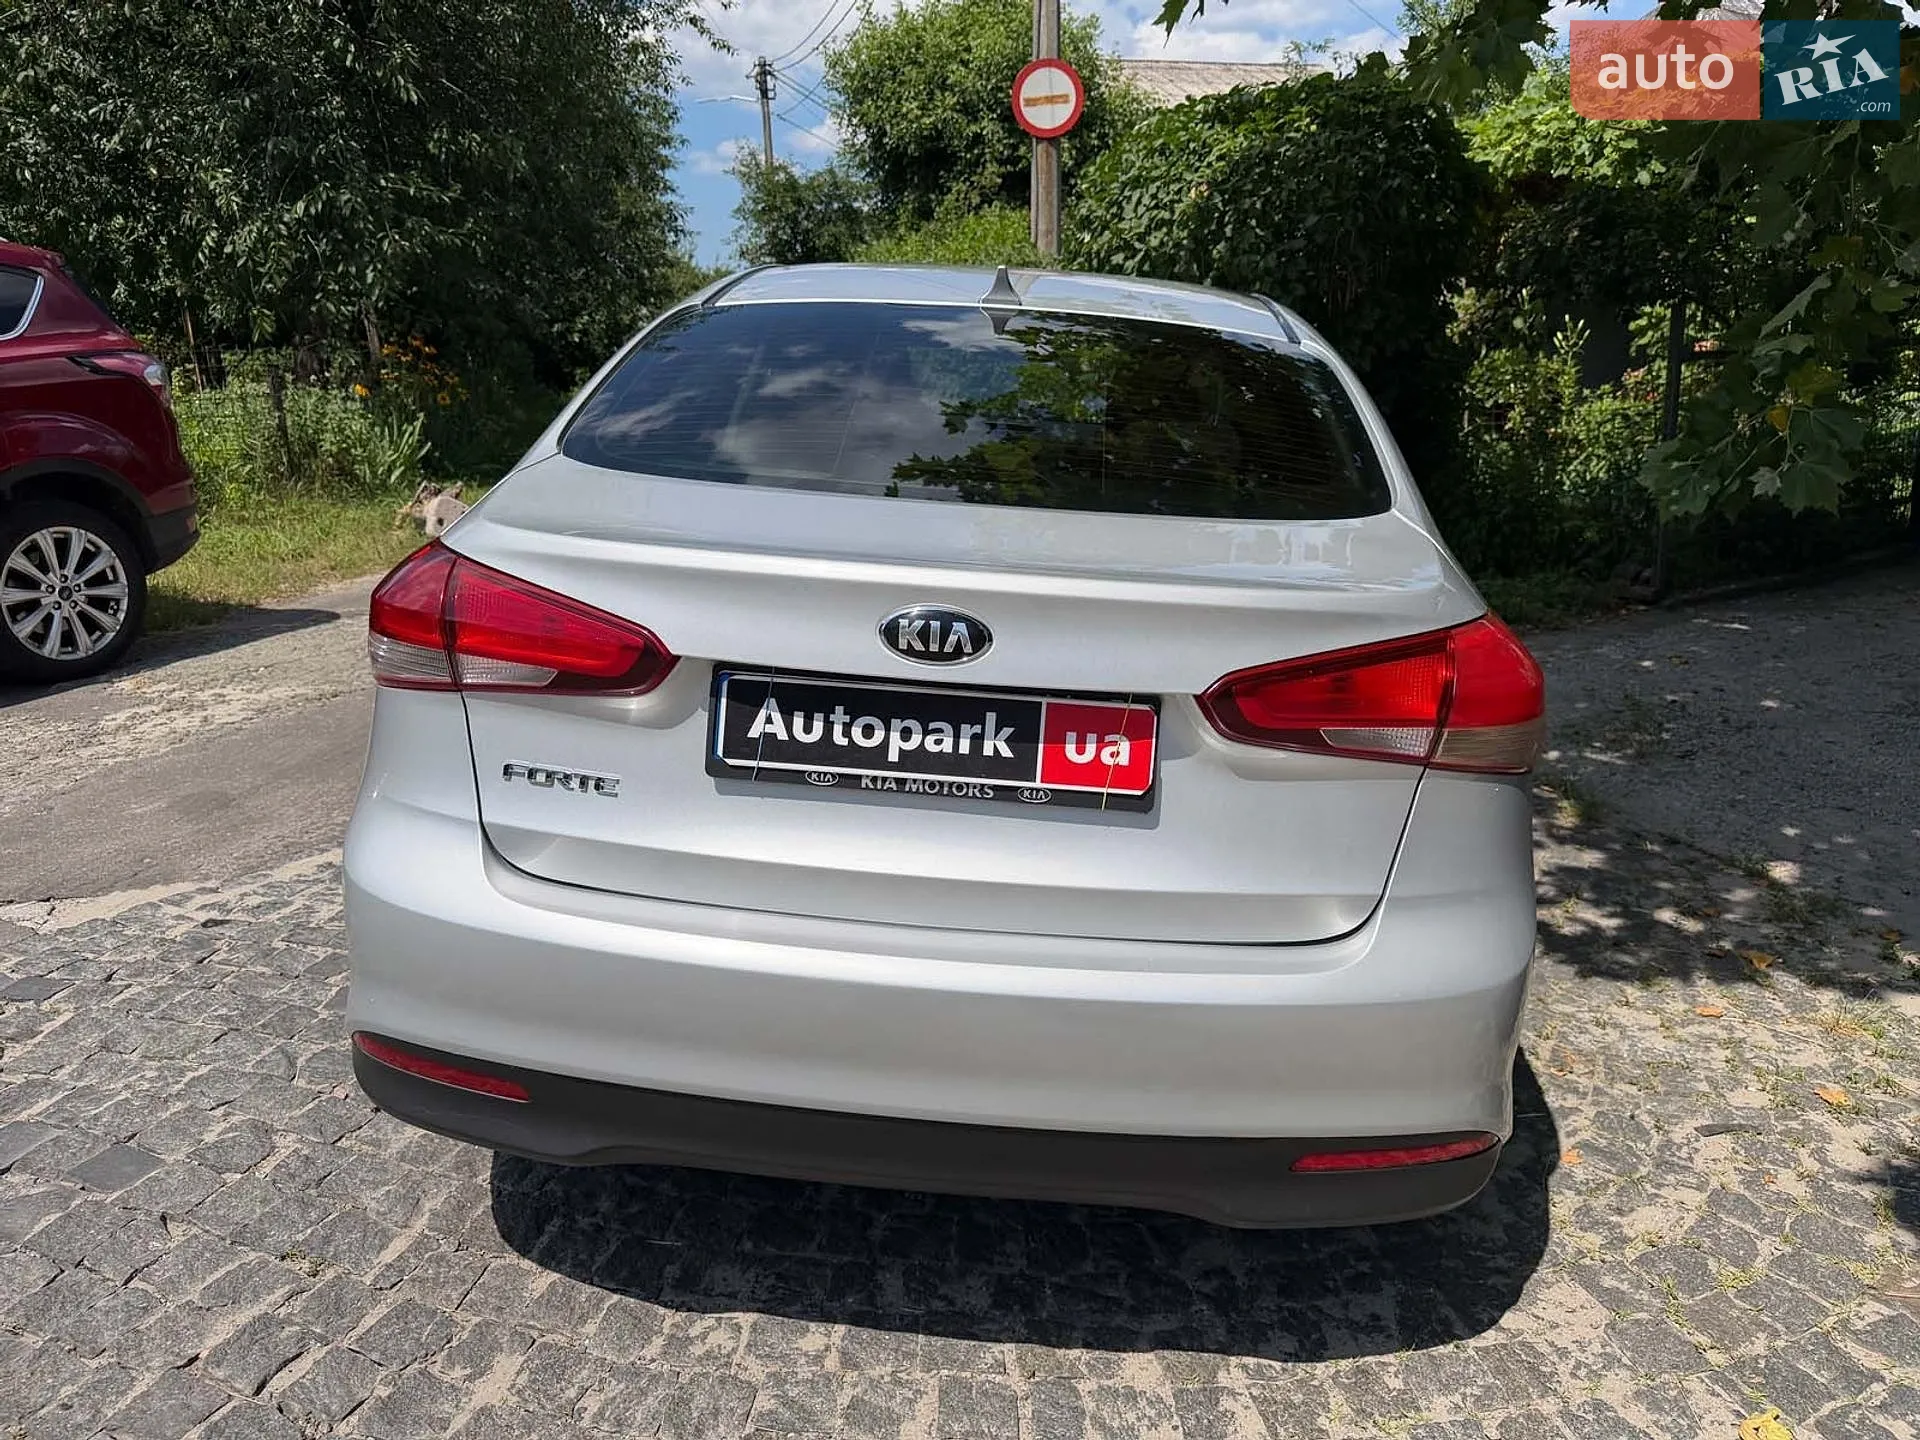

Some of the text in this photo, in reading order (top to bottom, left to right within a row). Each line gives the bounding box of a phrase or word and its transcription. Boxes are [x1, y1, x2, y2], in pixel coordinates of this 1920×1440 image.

[898, 618, 973, 653] KIA
[746, 697, 1132, 767] Autopark ua
[502, 759, 621, 798] FORTE
[861, 774, 995, 799] KIA MOTORS
[1022, 788, 1046, 800] KIA
